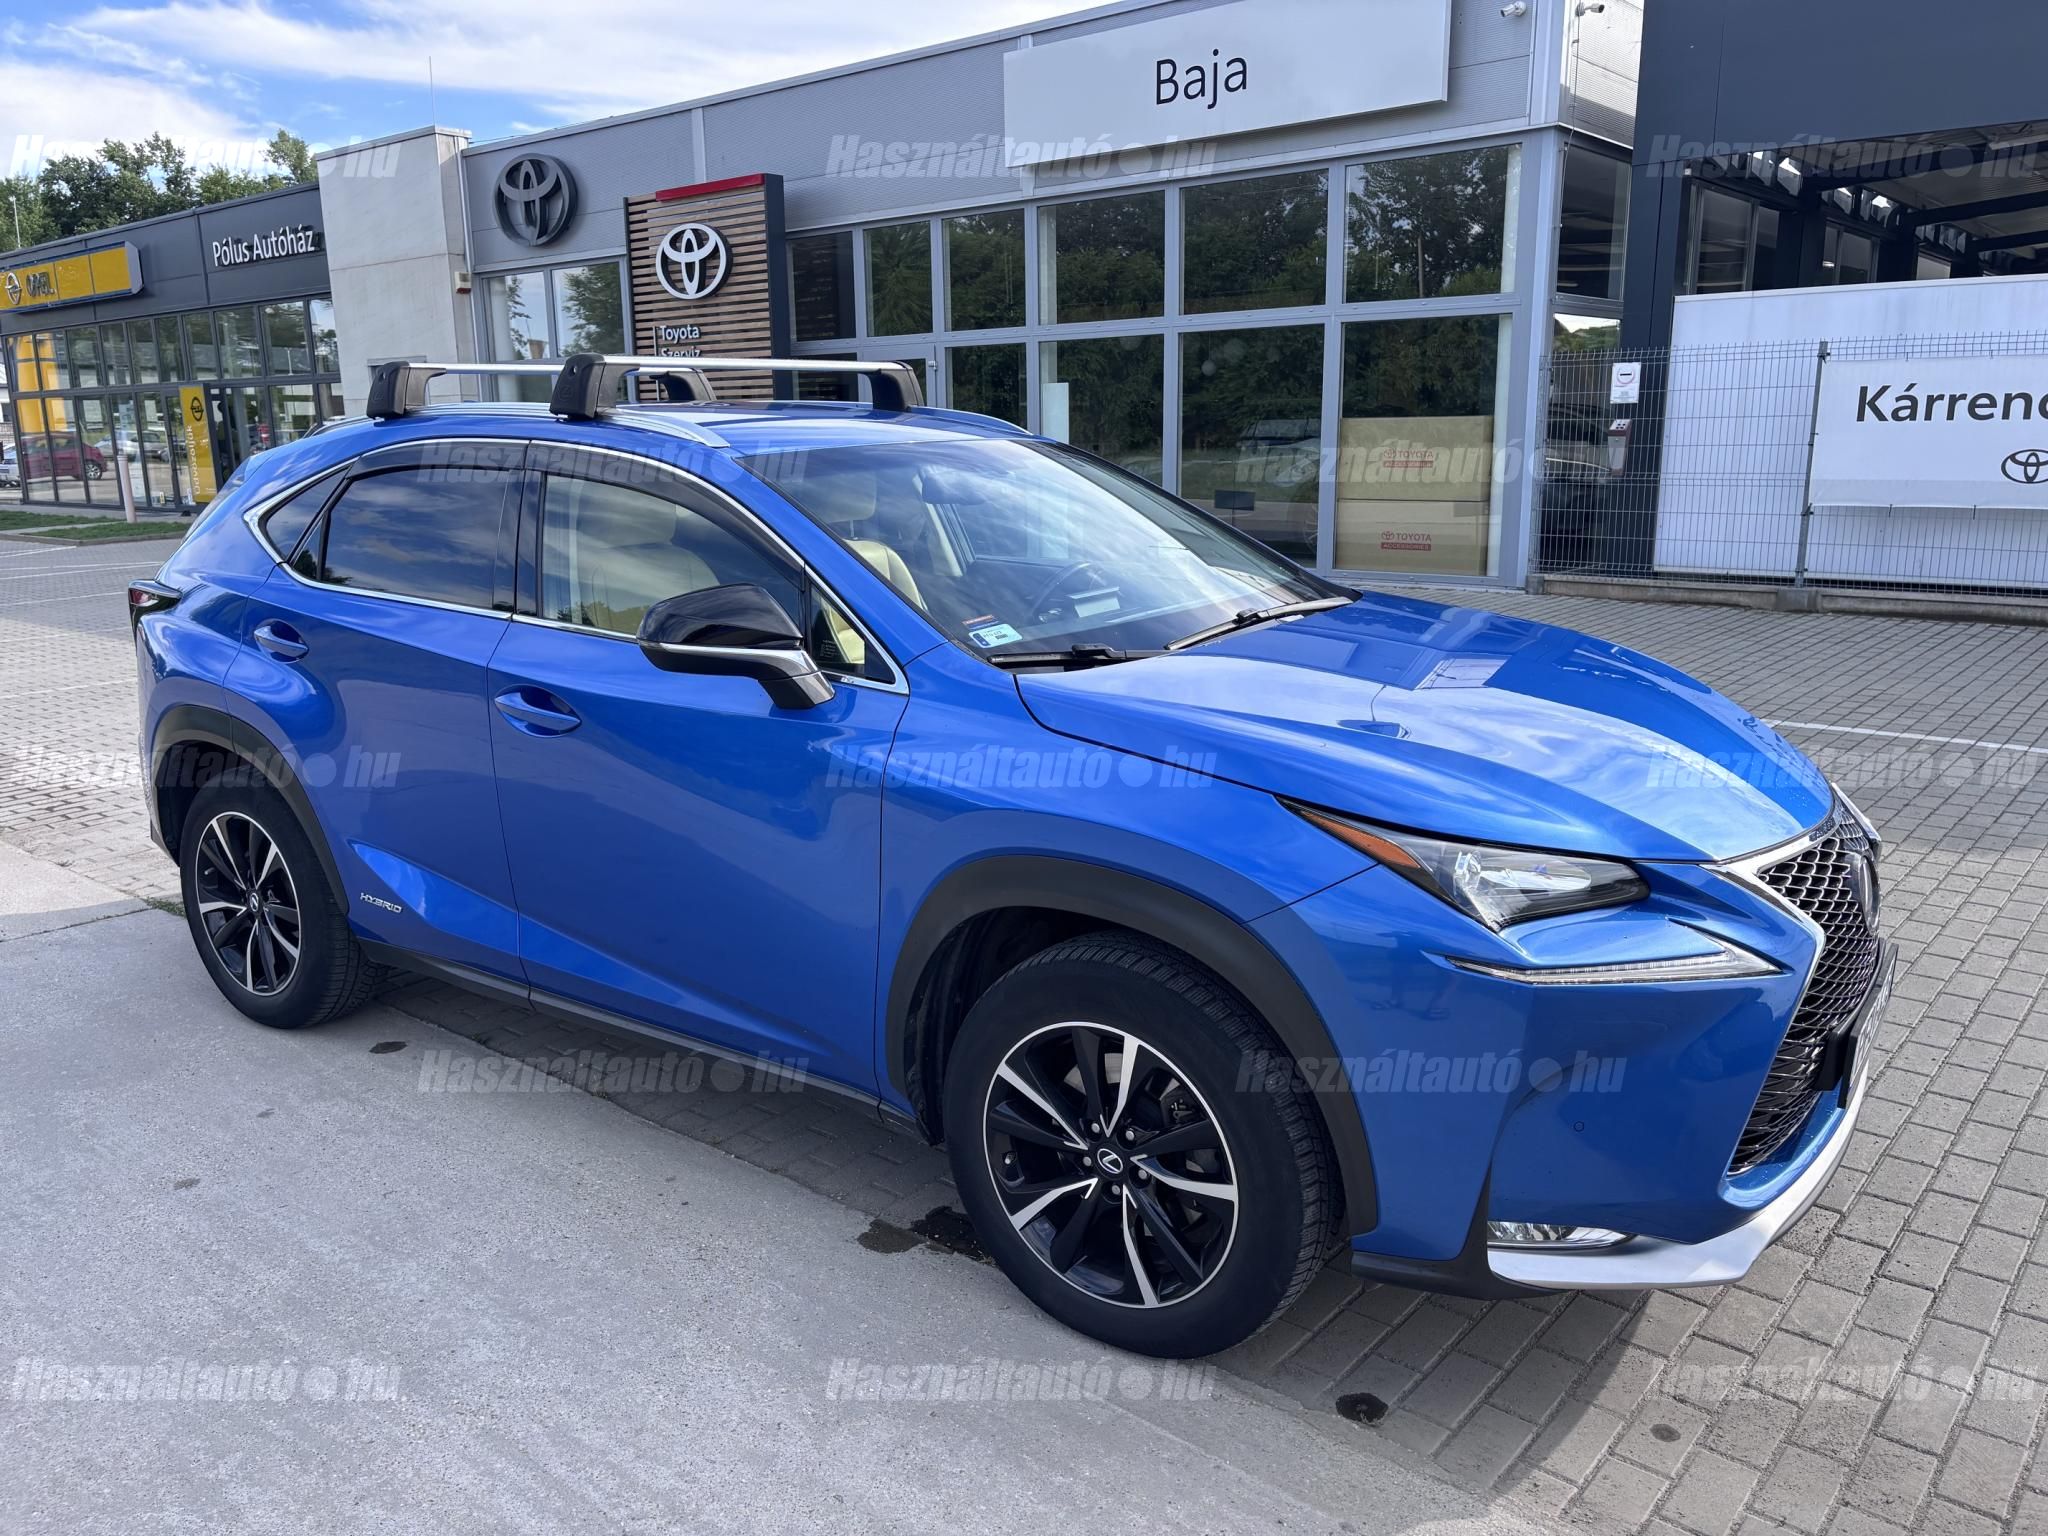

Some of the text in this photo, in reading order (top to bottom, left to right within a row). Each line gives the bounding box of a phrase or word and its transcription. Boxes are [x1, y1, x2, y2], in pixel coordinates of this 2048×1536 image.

[1156, 48, 1247, 109] Baja
[212, 223, 315, 267] Pólus Autóház
[660, 324, 699, 344] Toyota
[1398, 450, 1433, 459] TOYOTA
[1396, 532, 1432, 541] TOYOTA
[360, 892, 402, 913] HYBRID
